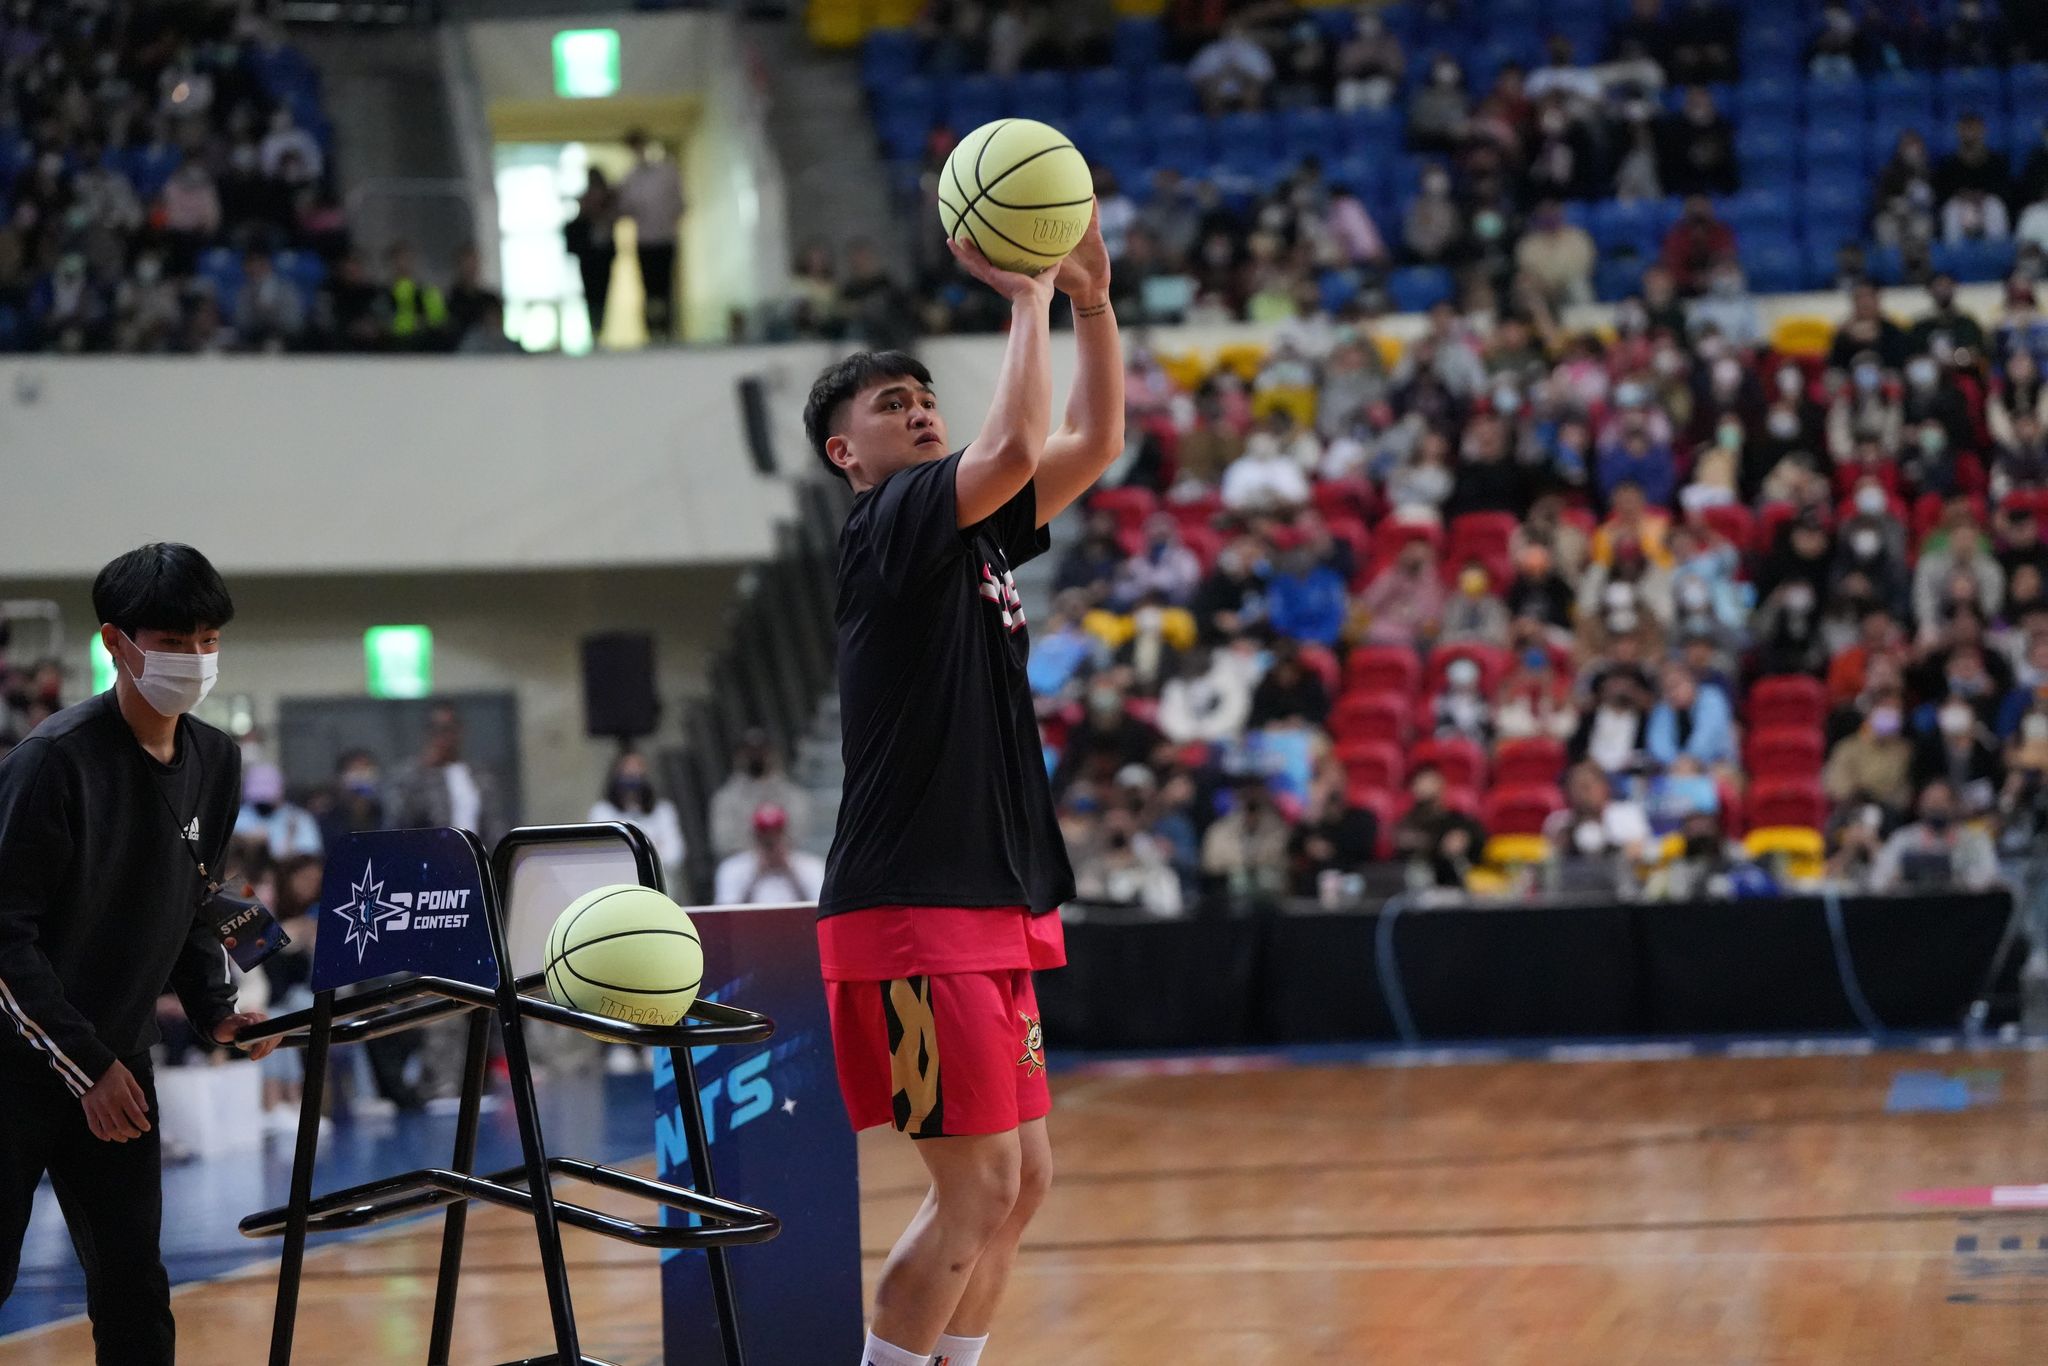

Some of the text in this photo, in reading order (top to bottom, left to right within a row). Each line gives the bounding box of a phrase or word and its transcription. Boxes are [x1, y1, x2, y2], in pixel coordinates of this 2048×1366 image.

[1032, 217, 1083, 244] Wil
[416, 889, 471, 911] POINT
[220, 904, 260, 935] STAFF
[413, 914, 470, 930] CONTEST
